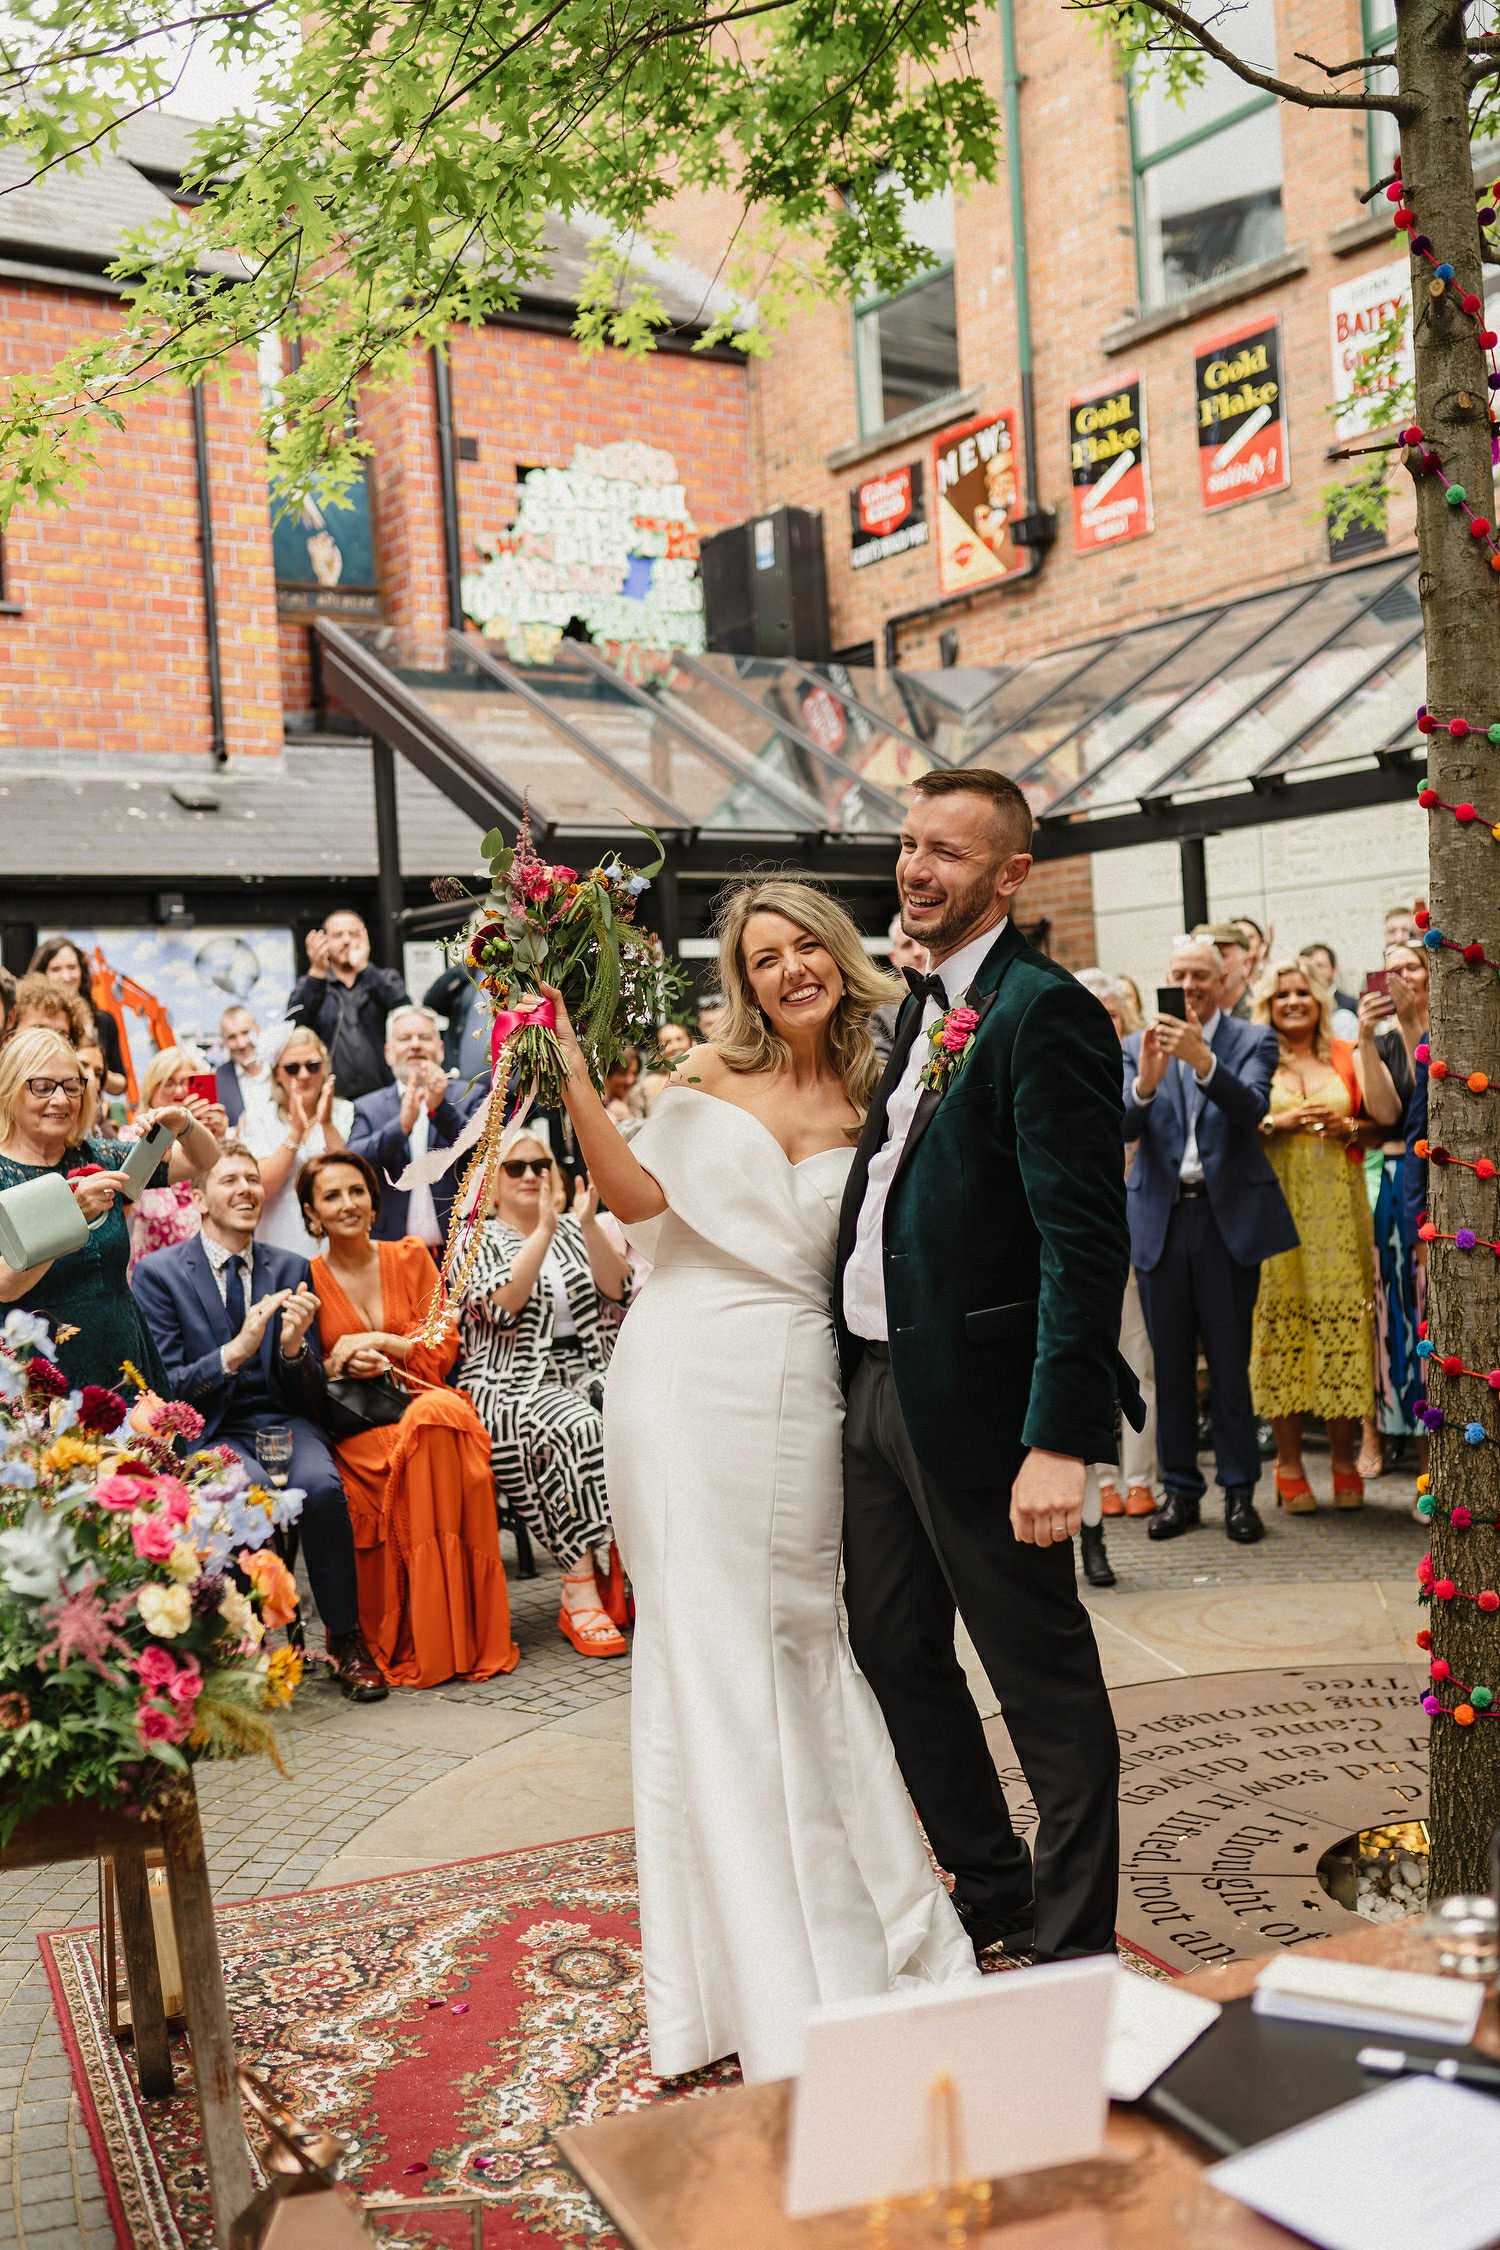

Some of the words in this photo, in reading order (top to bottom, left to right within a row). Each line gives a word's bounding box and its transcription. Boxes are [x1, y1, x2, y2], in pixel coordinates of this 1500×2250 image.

[1203, 343, 1270, 391] Gold
[1075, 393, 1134, 435] Gold
[1197, 381, 1279, 428] Flake
[1302, 1678, 1409, 1691] Tree
[1138, 1701, 1318, 1733] through
[1250, 1717, 1383, 1738] Came
[1258, 1739, 1388, 1761] been
[1116, 1757, 1249, 1806] driven
[1239, 1769, 1329, 1797] saw
[1197, 1793, 1251, 1810] it
[1265, 1812, 1309, 1827] I
[1121, 1810, 1221, 1868] lifted,
[1201, 1825, 1284, 1917] thought
[1130, 1875, 1196, 1926] root
[1258, 1923, 1333, 1948] of
